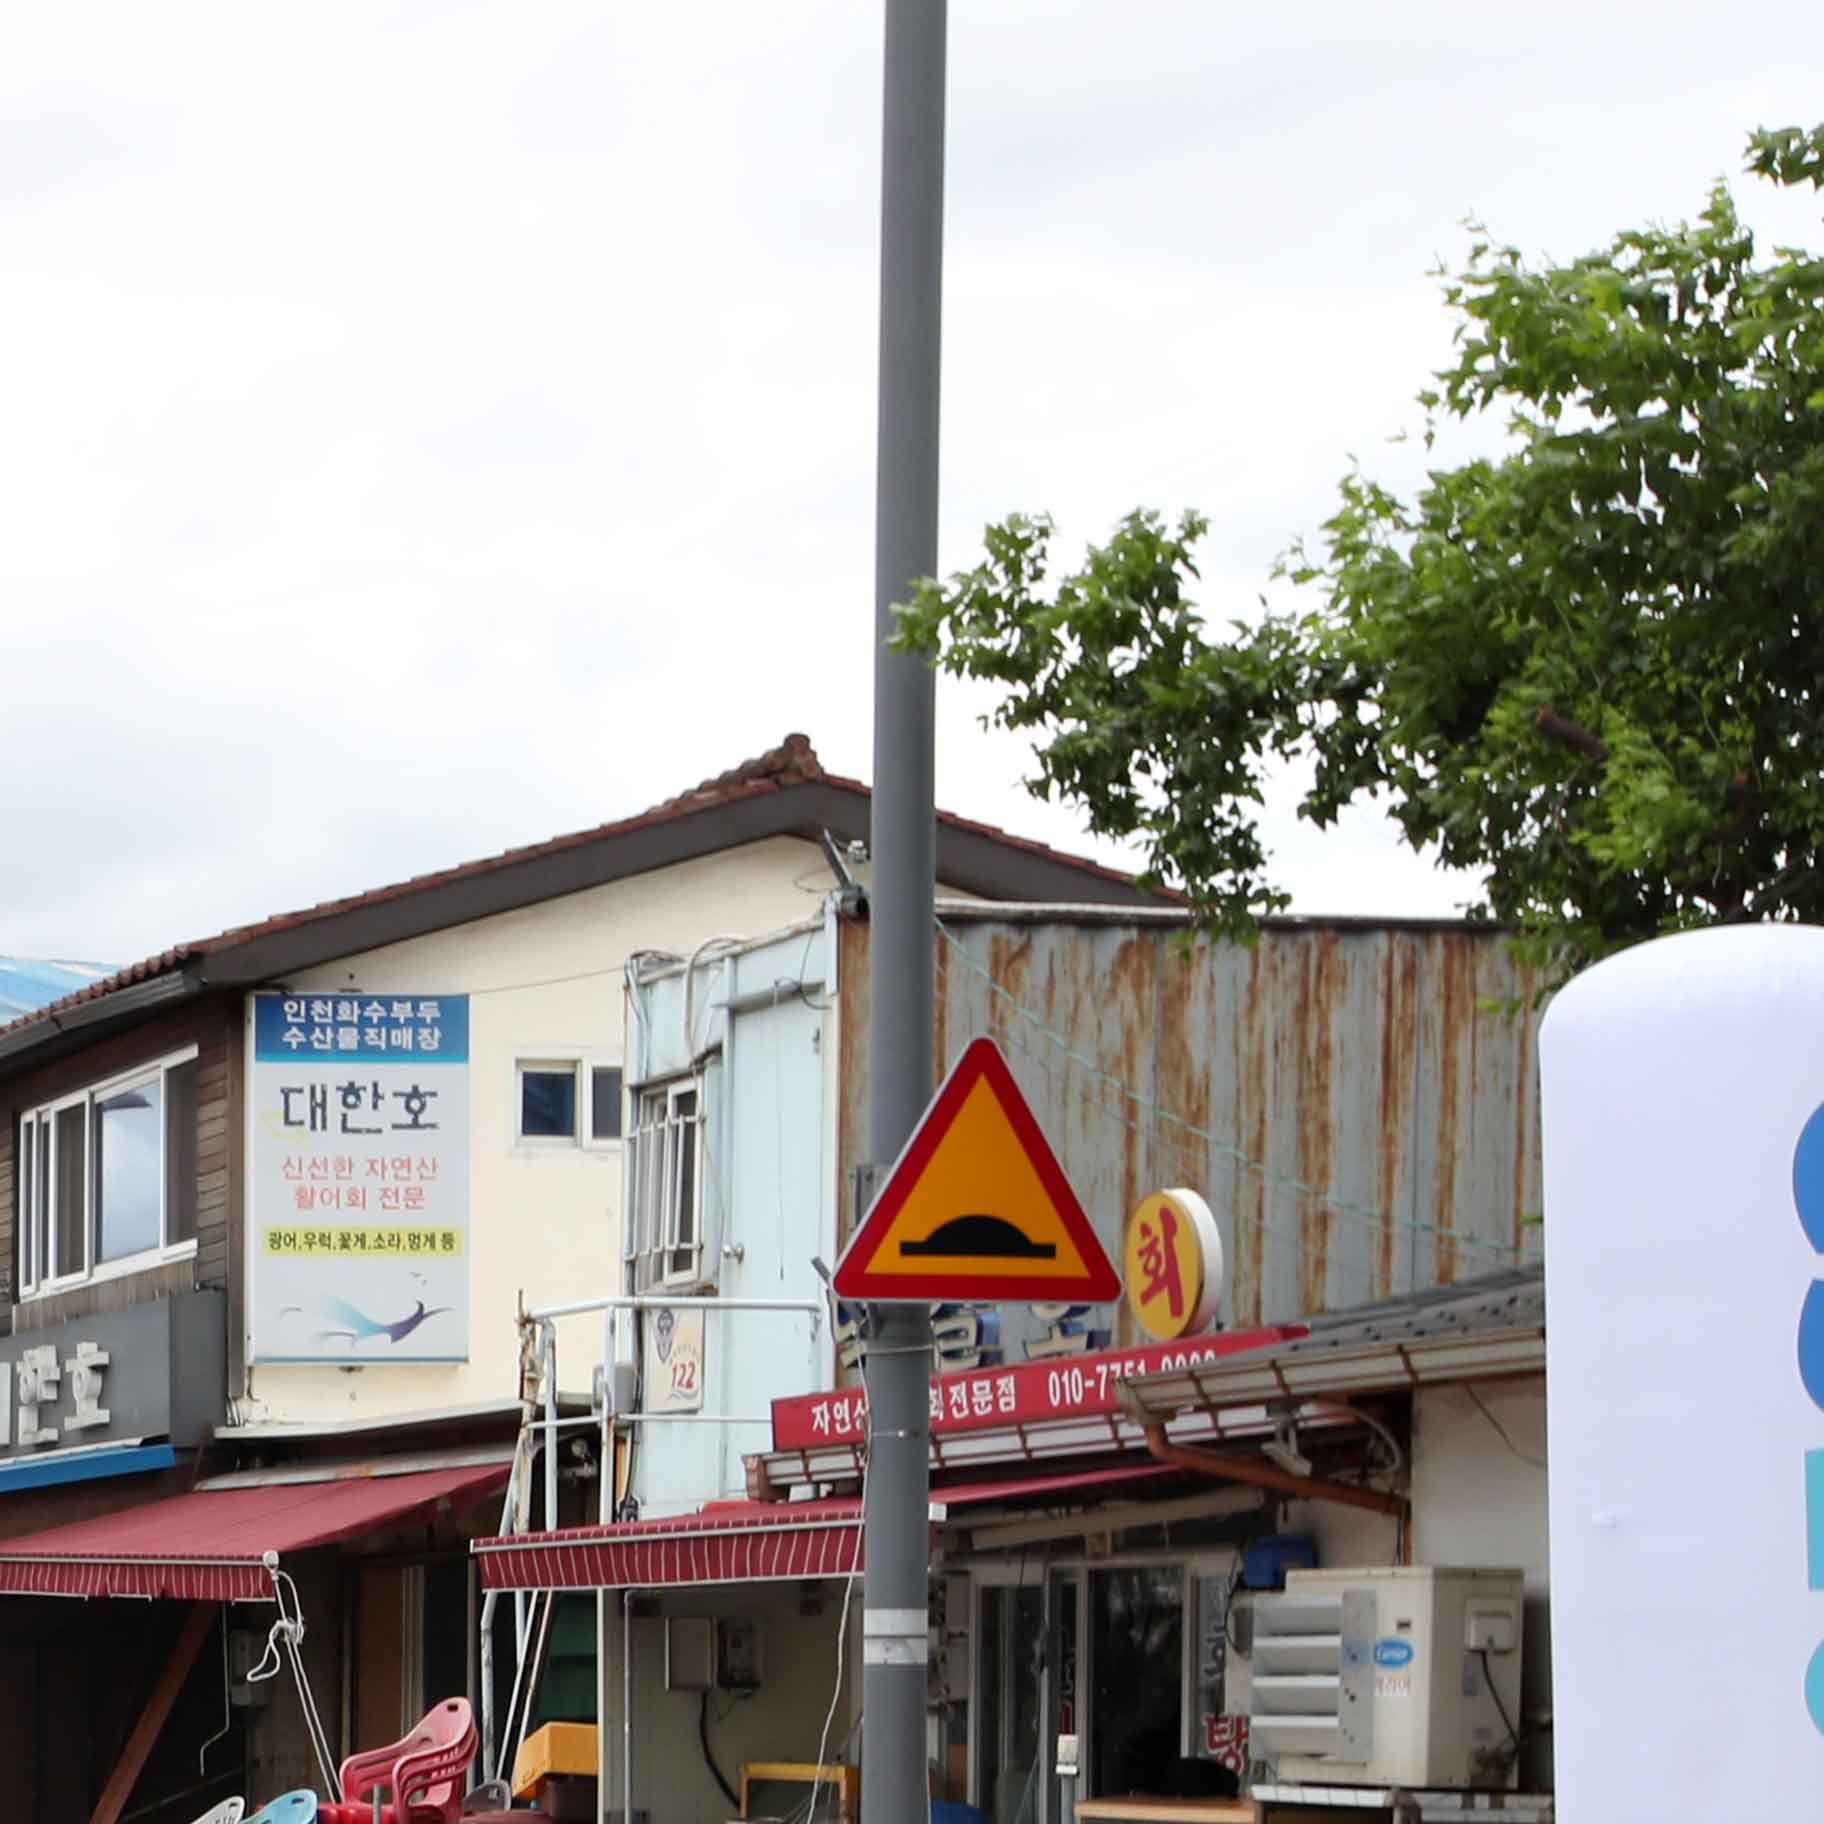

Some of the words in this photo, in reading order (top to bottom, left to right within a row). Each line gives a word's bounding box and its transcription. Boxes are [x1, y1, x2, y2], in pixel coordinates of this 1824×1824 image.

[282, 1000, 442, 1024] 인천화수부두
[282, 1026, 442, 1050] 수산물직매장
[280, 1080, 439, 1134] 대한호
[281, 1156, 354, 1181] 신선한
[366, 1156, 440, 1181] 자연산
[295, 1185, 368, 1211] 활어회
[379, 1186, 425, 1210] 전문
[441, 1232, 456, 1251] 등
[1138, 1204, 1185, 1319] 회
[672, 1360, 696, 1390] 122
[1204, 1716, 1249, 1775] 탕
